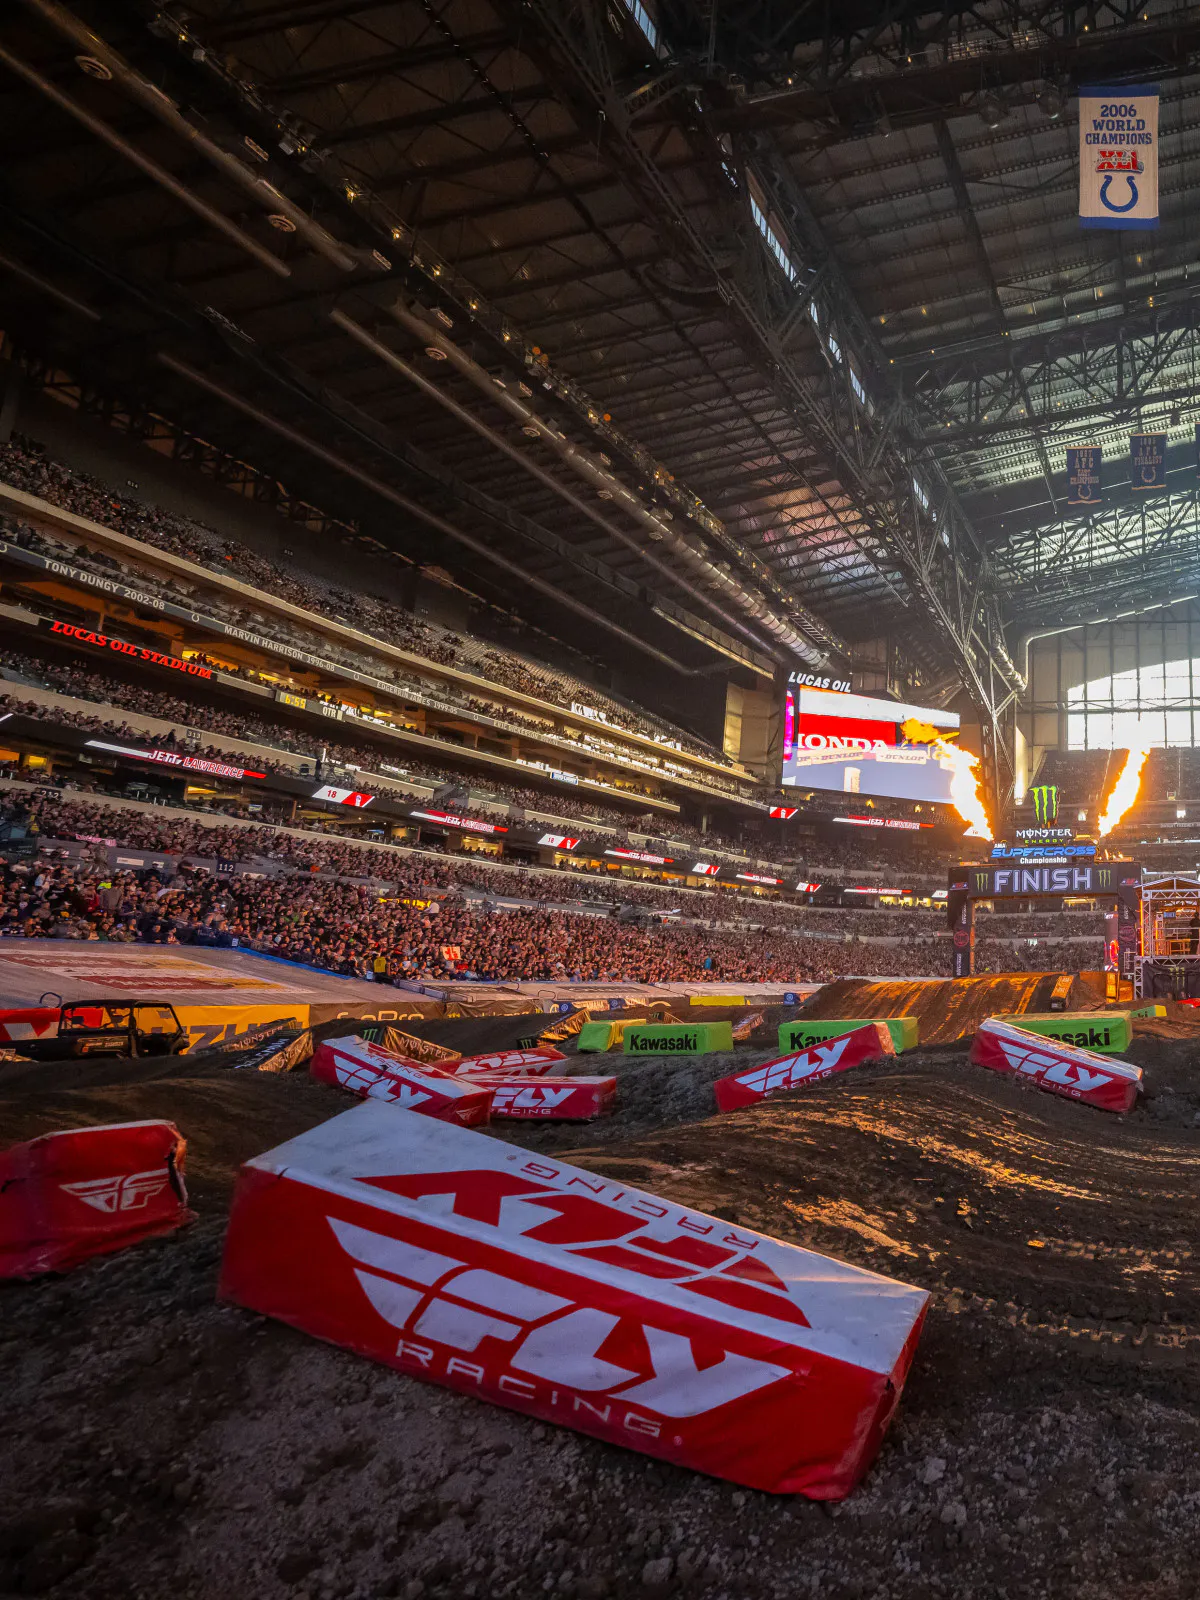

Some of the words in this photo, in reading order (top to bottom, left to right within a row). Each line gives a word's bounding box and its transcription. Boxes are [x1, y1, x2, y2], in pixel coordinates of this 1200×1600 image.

[1101, 104, 1137, 117] 2006
[1092, 119, 1145, 131] WORLD
[1085, 133, 1152, 145] CHAMPIONS
[1075, 458, 1094, 469] AFC
[1134, 455, 1163, 465] FINALIST
[44, 559, 78, 578] TONY
[80, 573, 120, 593] DUNGY
[124, 589, 165, 610] 2002-08
[50, 620, 108, 647] LUCAS
[110, 640, 138, 657] OIL
[140, 649, 213, 680] STADIUM
[224, 626, 260, 645] MARVIN
[261, 639, 304, 660] HARRISON
[306, 656, 335, 672] 1996-08
[789, 671, 830, 689] LUCAS
[832, 680, 851, 692] OIL
[322, 706, 336, 718] QTR
[148, 750, 181, 765] JETT
[182, 757, 245, 779] LAWRENCE
[821, 751, 863, 761] DUNLOP
[327, 789, 337, 798] 18
[1016, 828, 1072, 838] MONSTER
[991, 846, 1097, 858] SUPERCROSS
[218, 863, 234, 872] 112
[994, 868, 1092, 892] FINISH
[400, 1037, 447, 1060] MONSTER
[630, 1033, 698, 1051] Kawasaki
[750, 1038, 851, 1091] FLY
[1007, 1048, 1113, 1091] FLY
[340, 1062, 433, 1109] FLY
[1014, 1072, 1081, 1097] RACING
[490, 1088, 577, 1108] FLY
[370, 1240, 793, 1417] FLY
[395, 1338, 663, 1441] RACING
